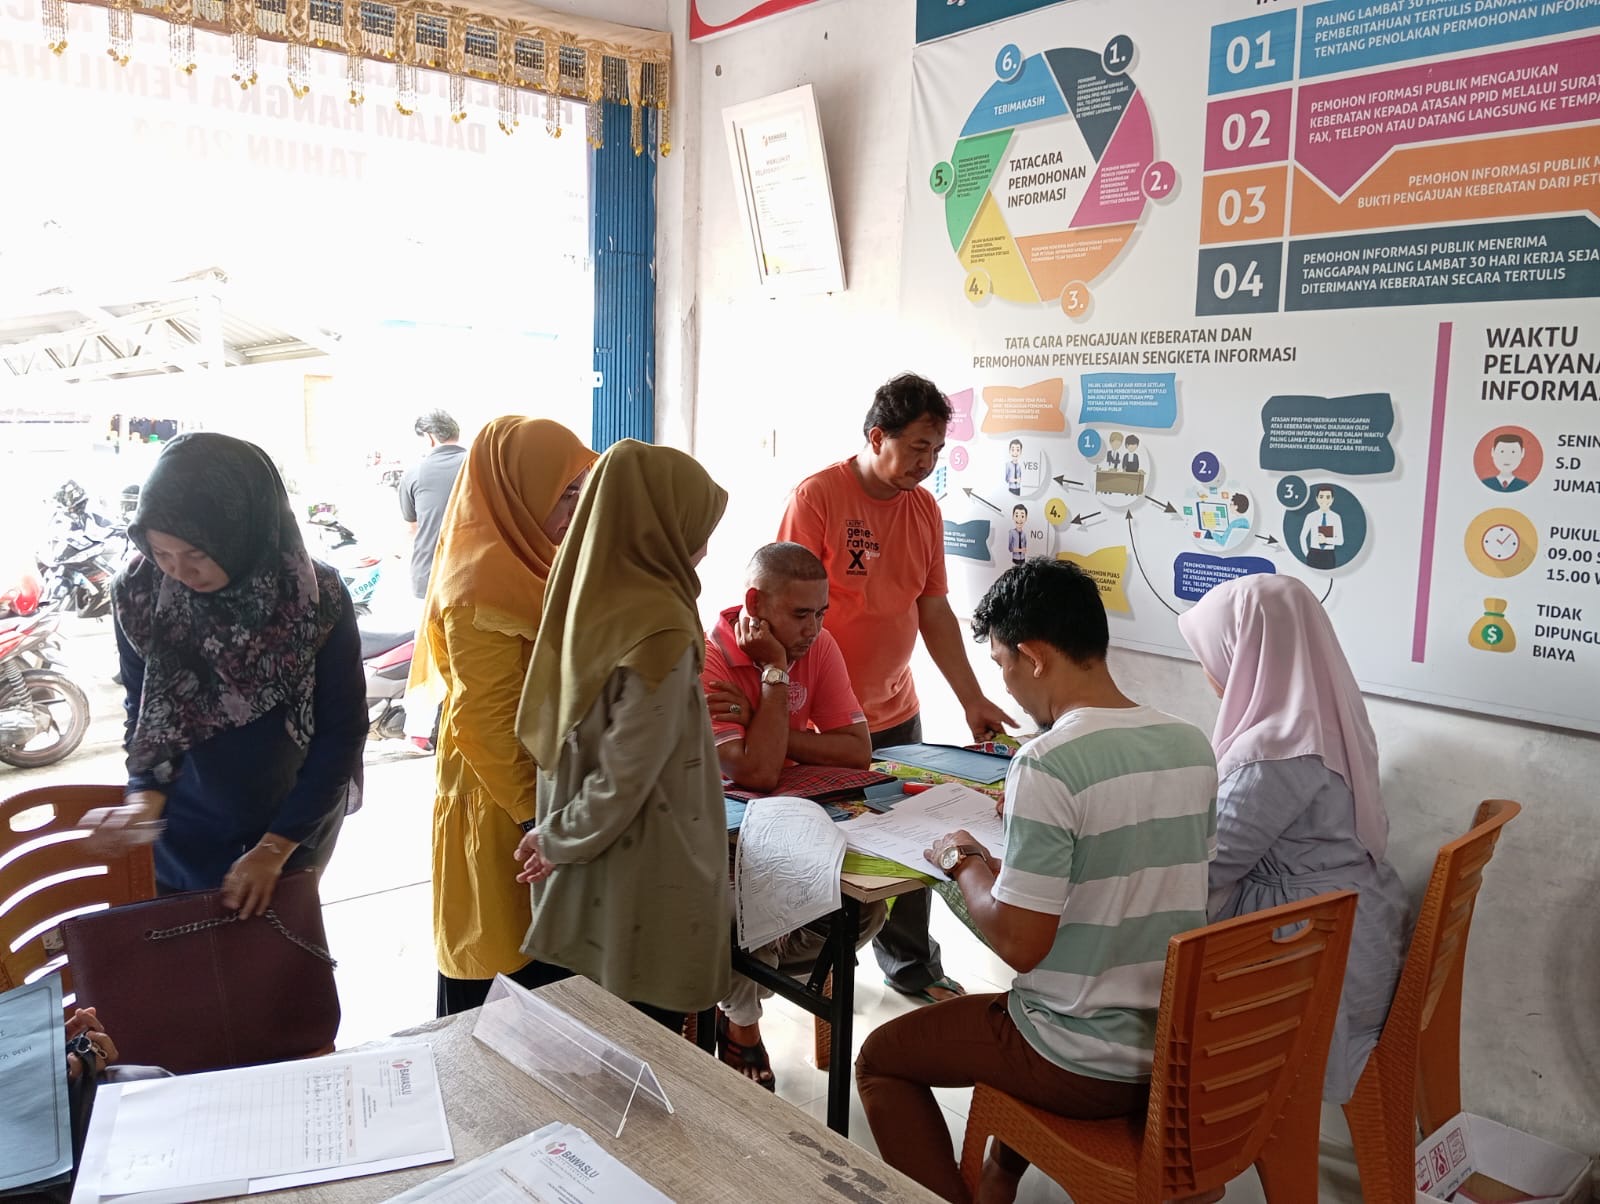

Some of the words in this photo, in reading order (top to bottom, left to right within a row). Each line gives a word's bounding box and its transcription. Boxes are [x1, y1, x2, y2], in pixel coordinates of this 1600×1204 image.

[1315, 14, 1411, 43] PEMBERITAHUAN
[1415, 3, 1471, 24] TERTULIS
[1316, 10, 1355, 28] PALING
[1358, 1, 1404, 19] LAMBAT
[1314, 39, 1365, 58] TENTANG
[1368, 23, 1440, 48] PENOLAKAN
[1443, 6, 1538, 34] PERMOHONAN
[1002, 53, 1017, 71] 6.
[1109, 43, 1126, 63] 1.
[1226, 30, 1276, 74] 01
[1311, 94, 1366, 113] PEMOHON
[1368, 85, 1423, 104] IFORMASI
[1425, 78, 1467, 96] PUBLIK
[1470, 63, 1558, 88] MENGAJUKAN
[994, 96, 1045, 116] TERIMAKASIH
[1310, 109, 1371, 129] KEBERATAN
[1374, 102, 1418, 120] KEPADA
[1421, 94, 1467, 112] ATASAN
[1470, 90, 1498, 104] PPID
[1502, 81, 1557, 100] MELALUI
[1222, 109, 1271, 151] 02
[1309, 131, 1332, 144] FAX,
[1335, 123, 1383, 140] TELEPON
[1386, 118, 1415, 133] ATAU
[1418, 111, 1465, 128] DATANG
[1468, 101, 1537, 121] LANGSUNG
[1541, 98, 1557, 111] KE
[1010, 151, 1063, 172] TATACARA
[1408, 170, 1471, 187] PEMOHON
[1472, 162, 1540, 181] INFORMASI
[1543, 157, 1590, 173] PUBLIK
[934, 169, 948, 187] 5.
[1008, 166, 1086, 190] PERMOHONAN
[1150, 171, 1168, 191] 2.
[1007, 188, 1066, 208] INFORMASI
[1358, 195, 1391, 208] BUKTI
[1393, 187, 1462, 205] PENGAJUAN
[1465, 181, 1536, 198] KEBERATAN
[1539, 177, 1570, 190] DARI
[1574, 172, 1600, 187] PET
[1218, 185, 1266, 226] 03
[1303, 249, 1360, 264] PEMOHON
[1363, 244, 1428, 260] INFORMASI
[1431, 240, 1475, 254] PUBLIK
[1478, 235, 1547, 251] MENERIMA
[1303, 264, 1370, 279] TANGGAPAN
[1372, 260, 1414, 274] PALING
[1417, 257, 1467, 271] LAMBAT
[1469, 256, 1486, 268] 30
[1489, 254, 1520, 267] HARI
[1524, 251, 1564, 265] KERJA
[1568, 249, 1600, 262] SEJA
[969, 278, 983, 295] 4.
[1213, 260, 1264, 300] 04
[1301, 280, 1377, 294] DITERIMANYA
[1380, 274, 1449, 289] KEBERATAN
[1451, 271, 1501, 286] SECARA
[1504, 268, 1566, 282] TERTULIS
[1069, 290, 1084, 309] 3.
[1005, 336, 1030, 350] TATA
[1032, 335, 1063, 348] CARA
[1066, 332, 1137, 347] PENGAJUAN
[1140, 328, 1217, 344] KEBERATAN
[1220, 327, 1252, 342] DAN
[1486, 326, 1578, 348] WAKTU
[973, 354, 1049, 368] PERMOHONAN
[1052, 351, 1139, 366] PENYELESAIAN
[1142, 349, 1211, 365] SENGKETA
[1214, 347, 1297, 363] INFORMASI
[1481, 380, 1600, 401] INFORMA
[1084, 436, 1095, 448] 1.
[1023, 462, 1038, 471] YES
[1199, 460, 1211, 474] 2.
[1555, 457, 1581, 470] S.D
[1284, 484, 1298, 499] 3.
[1050, 505, 1061, 518] 4.
[1030, 530, 1044, 540] NO
[1550, 527, 1600, 542] PUKUL
[848, 550, 865, 569] X
[1548, 547, 1592, 563] 09.00
[1547, 568, 1591, 584] 15.00
[1536, 604, 1582, 621] TIDAK
[1533, 645, 1576, 662] BIAYA
[561, 1150, 600, 1178] BAWASLU
